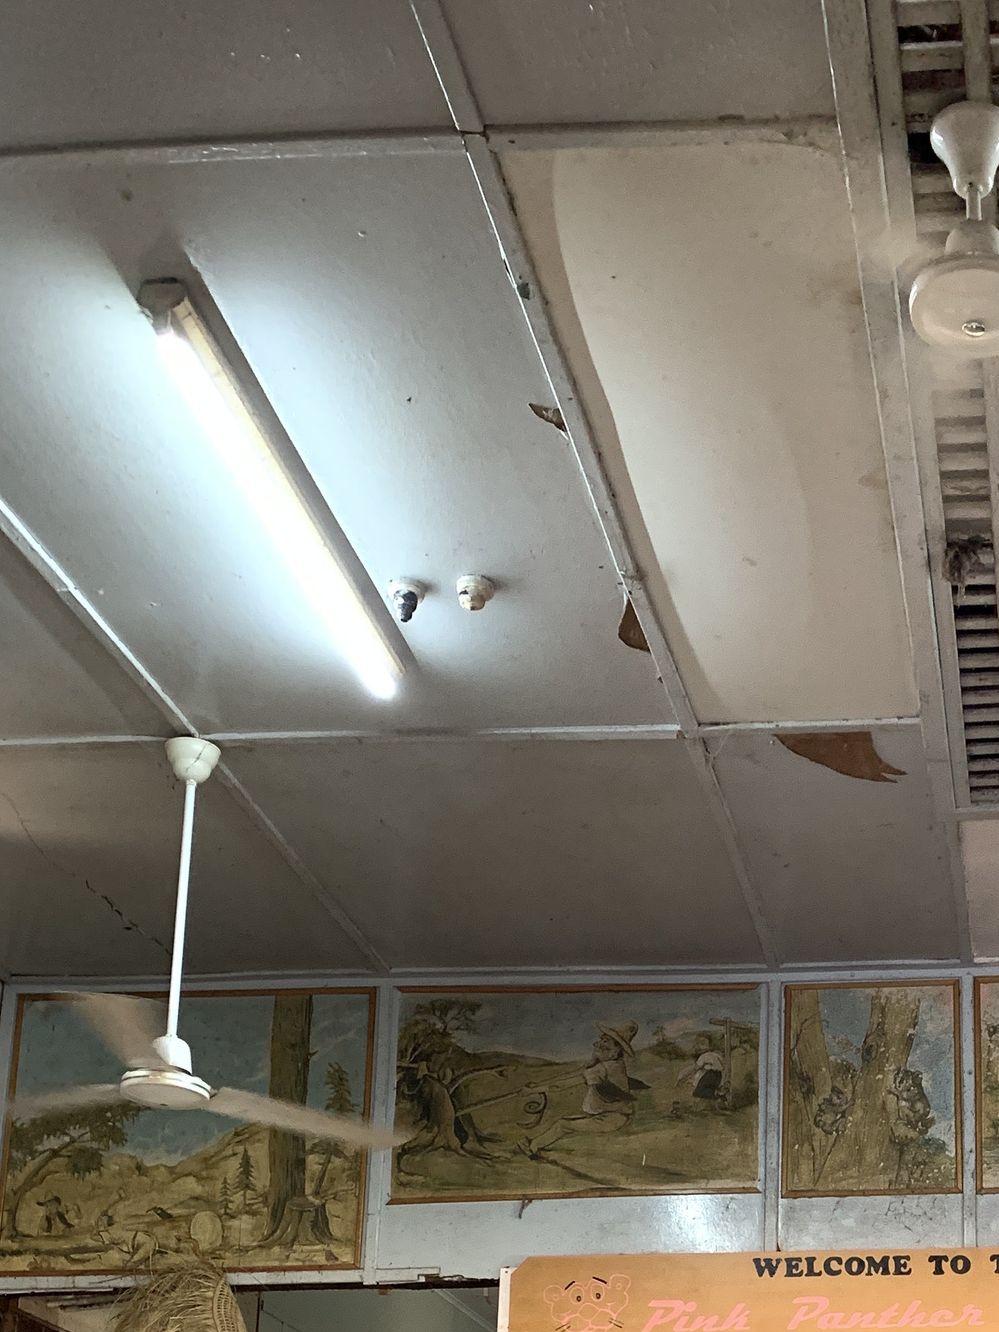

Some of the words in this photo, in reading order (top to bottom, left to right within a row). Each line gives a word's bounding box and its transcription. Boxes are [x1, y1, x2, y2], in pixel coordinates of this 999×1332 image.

[752, 1254, 912, 1278] WELCOME
[928, 1253, 972, 1276] TO
[785, 1295, 987, 1331] Panther
